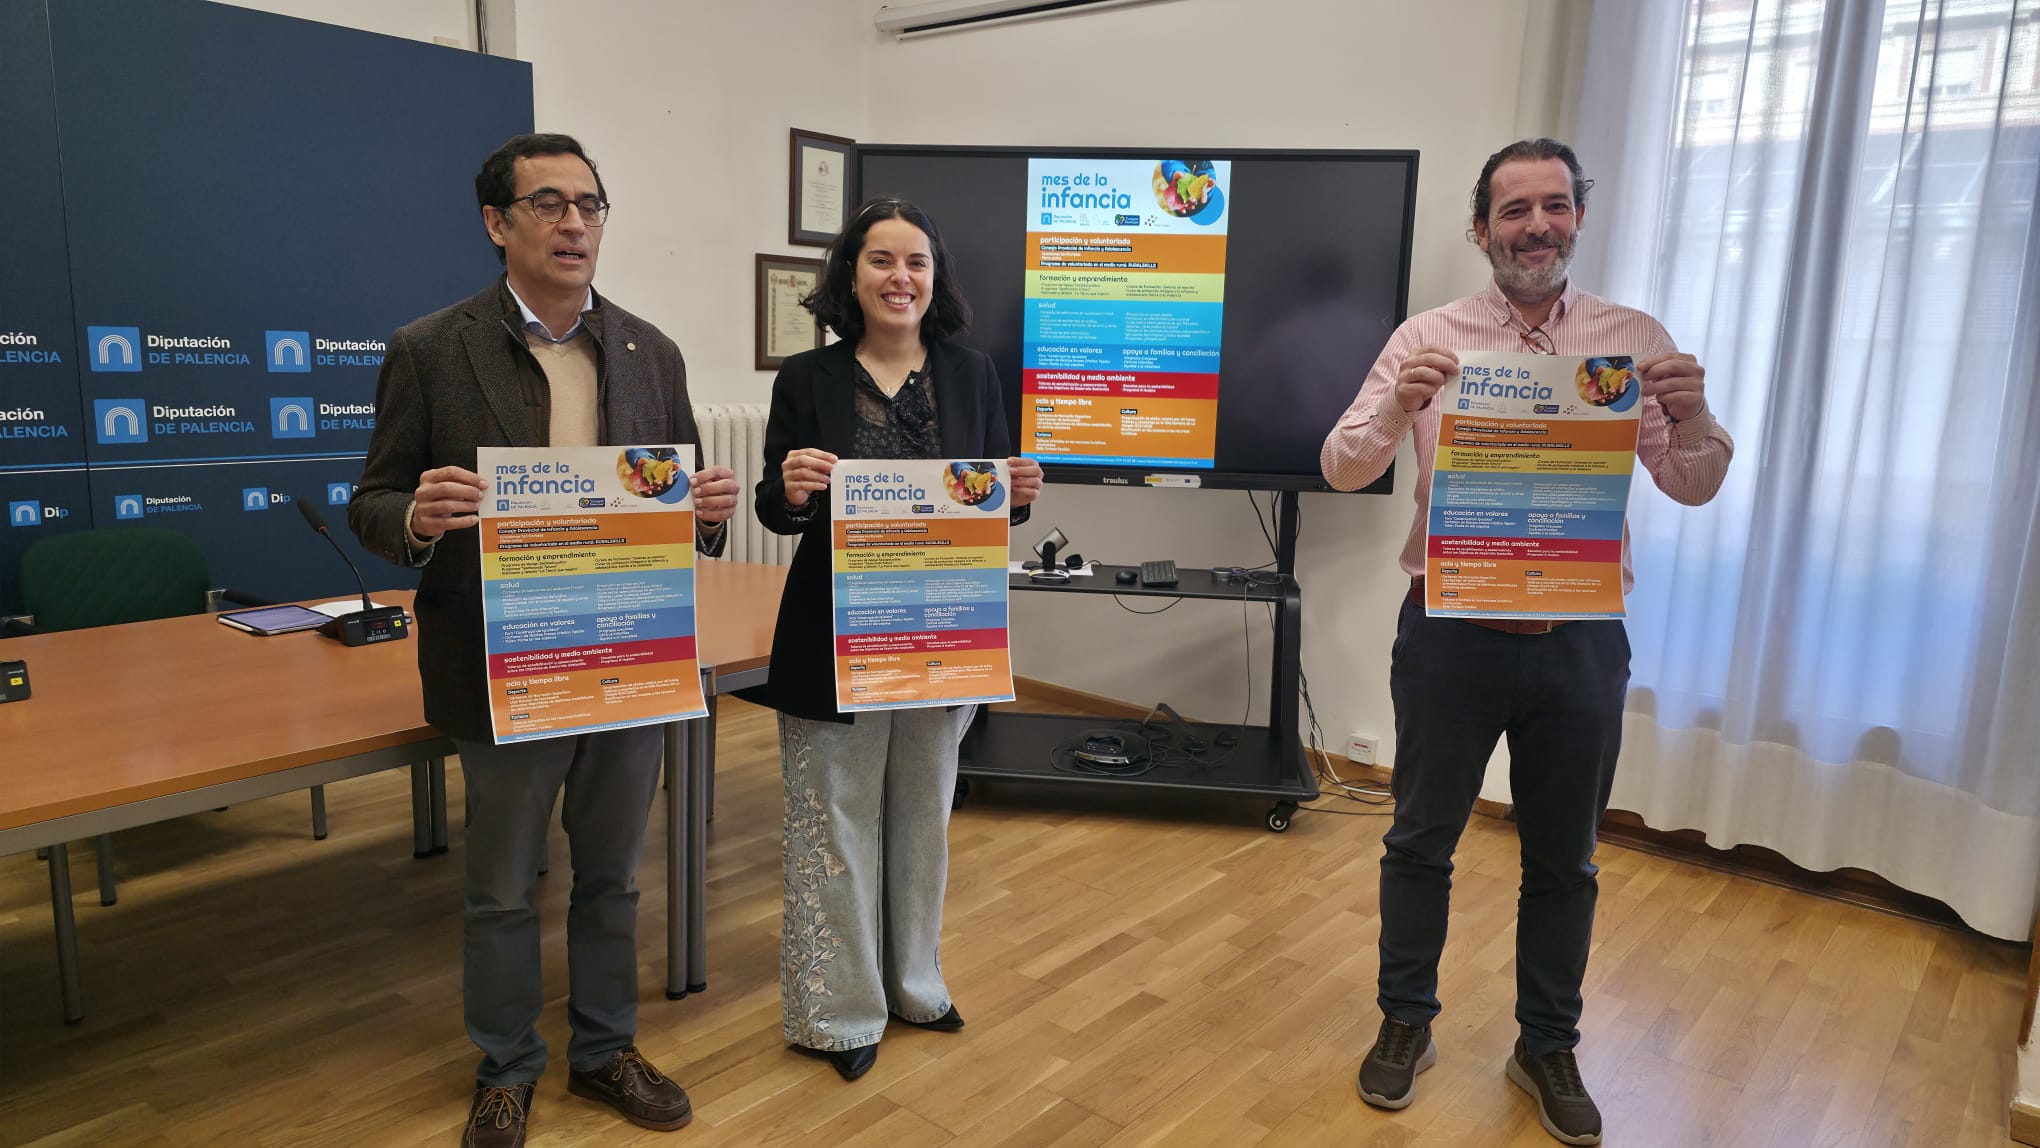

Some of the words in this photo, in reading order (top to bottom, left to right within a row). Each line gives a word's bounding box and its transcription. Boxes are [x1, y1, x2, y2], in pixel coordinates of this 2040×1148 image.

[1042, 175, 1068, 185] mes
[1074, 173, 1090, 185] de
[1096, 173, 1107, 186] la
[1042, 187, 1131, 209] infancia
[1040, 237, 1082, 245] participación
[148, 335, 230, 349] Diputación
[316, 339, 385, 352] Diputación
[0, 351, 62, 363] ENCIA
[149, 353, 170, 364] DE
[176, 353, 250, 364] PALENCIA
[317, 355, 335, 365] DE
[1463, 366, 1490, 376] mes
[1495, 366, 1512, 378] de
[1517, 367, 1530, 379] la
[1461, 376, 1553, 400] infancia
[1056, 398, 1076, 406] tiempo
[153, 405, 235, 419] Diputación
[320, 404, 375, 416] Diputaci
[155, 423, 176, 434] DE
[181, 421, 255, 433] PALENCIA
[321, 420, 339, 429] DE
[1456, 420, 1498, 428] participación
[0, 425, 68, 438] LENCIA
[496, 464, 526, 474] mes
[532, 462, 550, 473] de
[556, 462, 569, 473] la
[845, 475, 869, 483] mes
[874, 473, 888, 483] de
[894, 473, 904, 483] la
[496, 474, 595, 495] infancia
[271, 493, 290, 504] Dip
[846, 484, 925, 501] infancia
[146, 496, 191, 505] Diputación
[44, 507, 69, 519] Dip
[161, 504, 202, 512] PALENCIA
[497, 519, 544, 528] participación
[543, 552, 596, 560] emprendimiento
[502, 622, 538, 630] educación
[596, 620, 635, 628] conciliación
[504, 652, 553, 663] sostenibilidad
[583, 648, 612, 656] ambiente
[529, 677, 552, 685] tiempo
